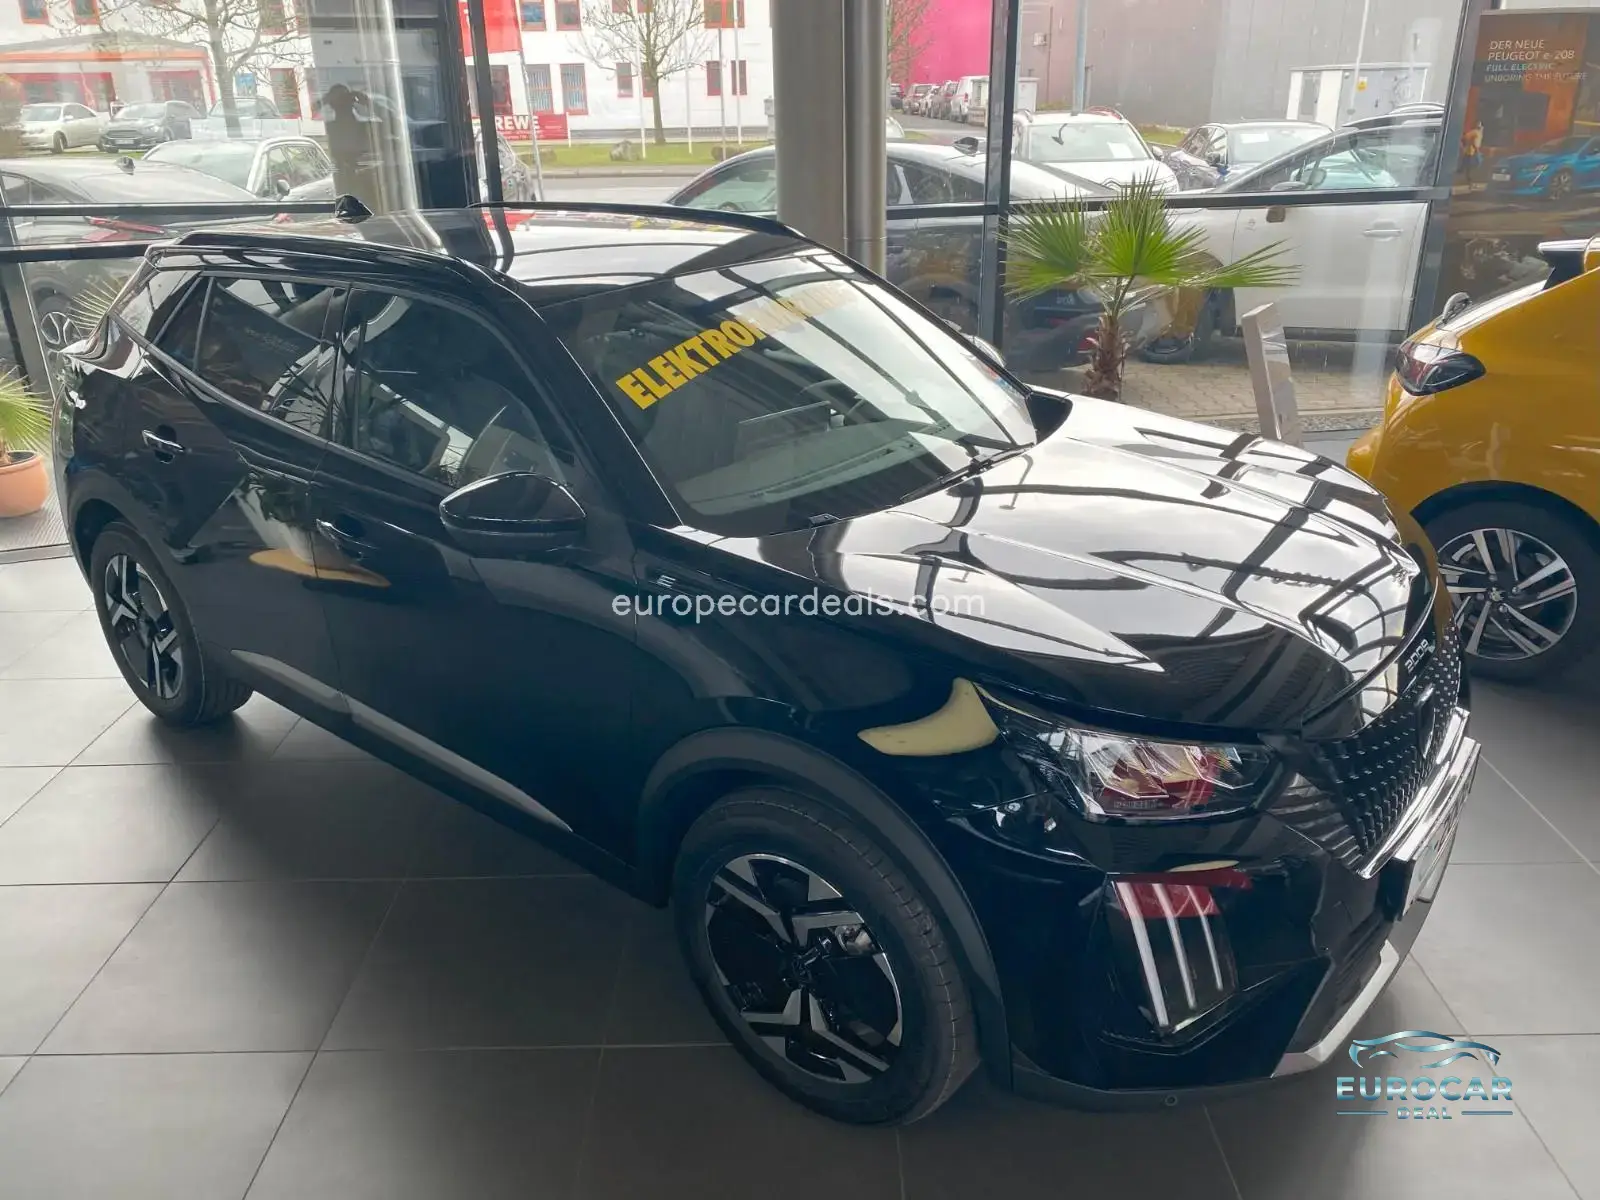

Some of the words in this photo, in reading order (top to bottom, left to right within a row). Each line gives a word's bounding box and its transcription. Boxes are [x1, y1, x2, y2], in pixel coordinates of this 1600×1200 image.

[1489, 40, 1512, 50] DER
[1514, 39, 1545, 49] NEUE
[1487, 50, 1541, 61] PEUGEOT
[1485, 63, 1510, 72] FULL
[495, 115, 540, 131] REWE
